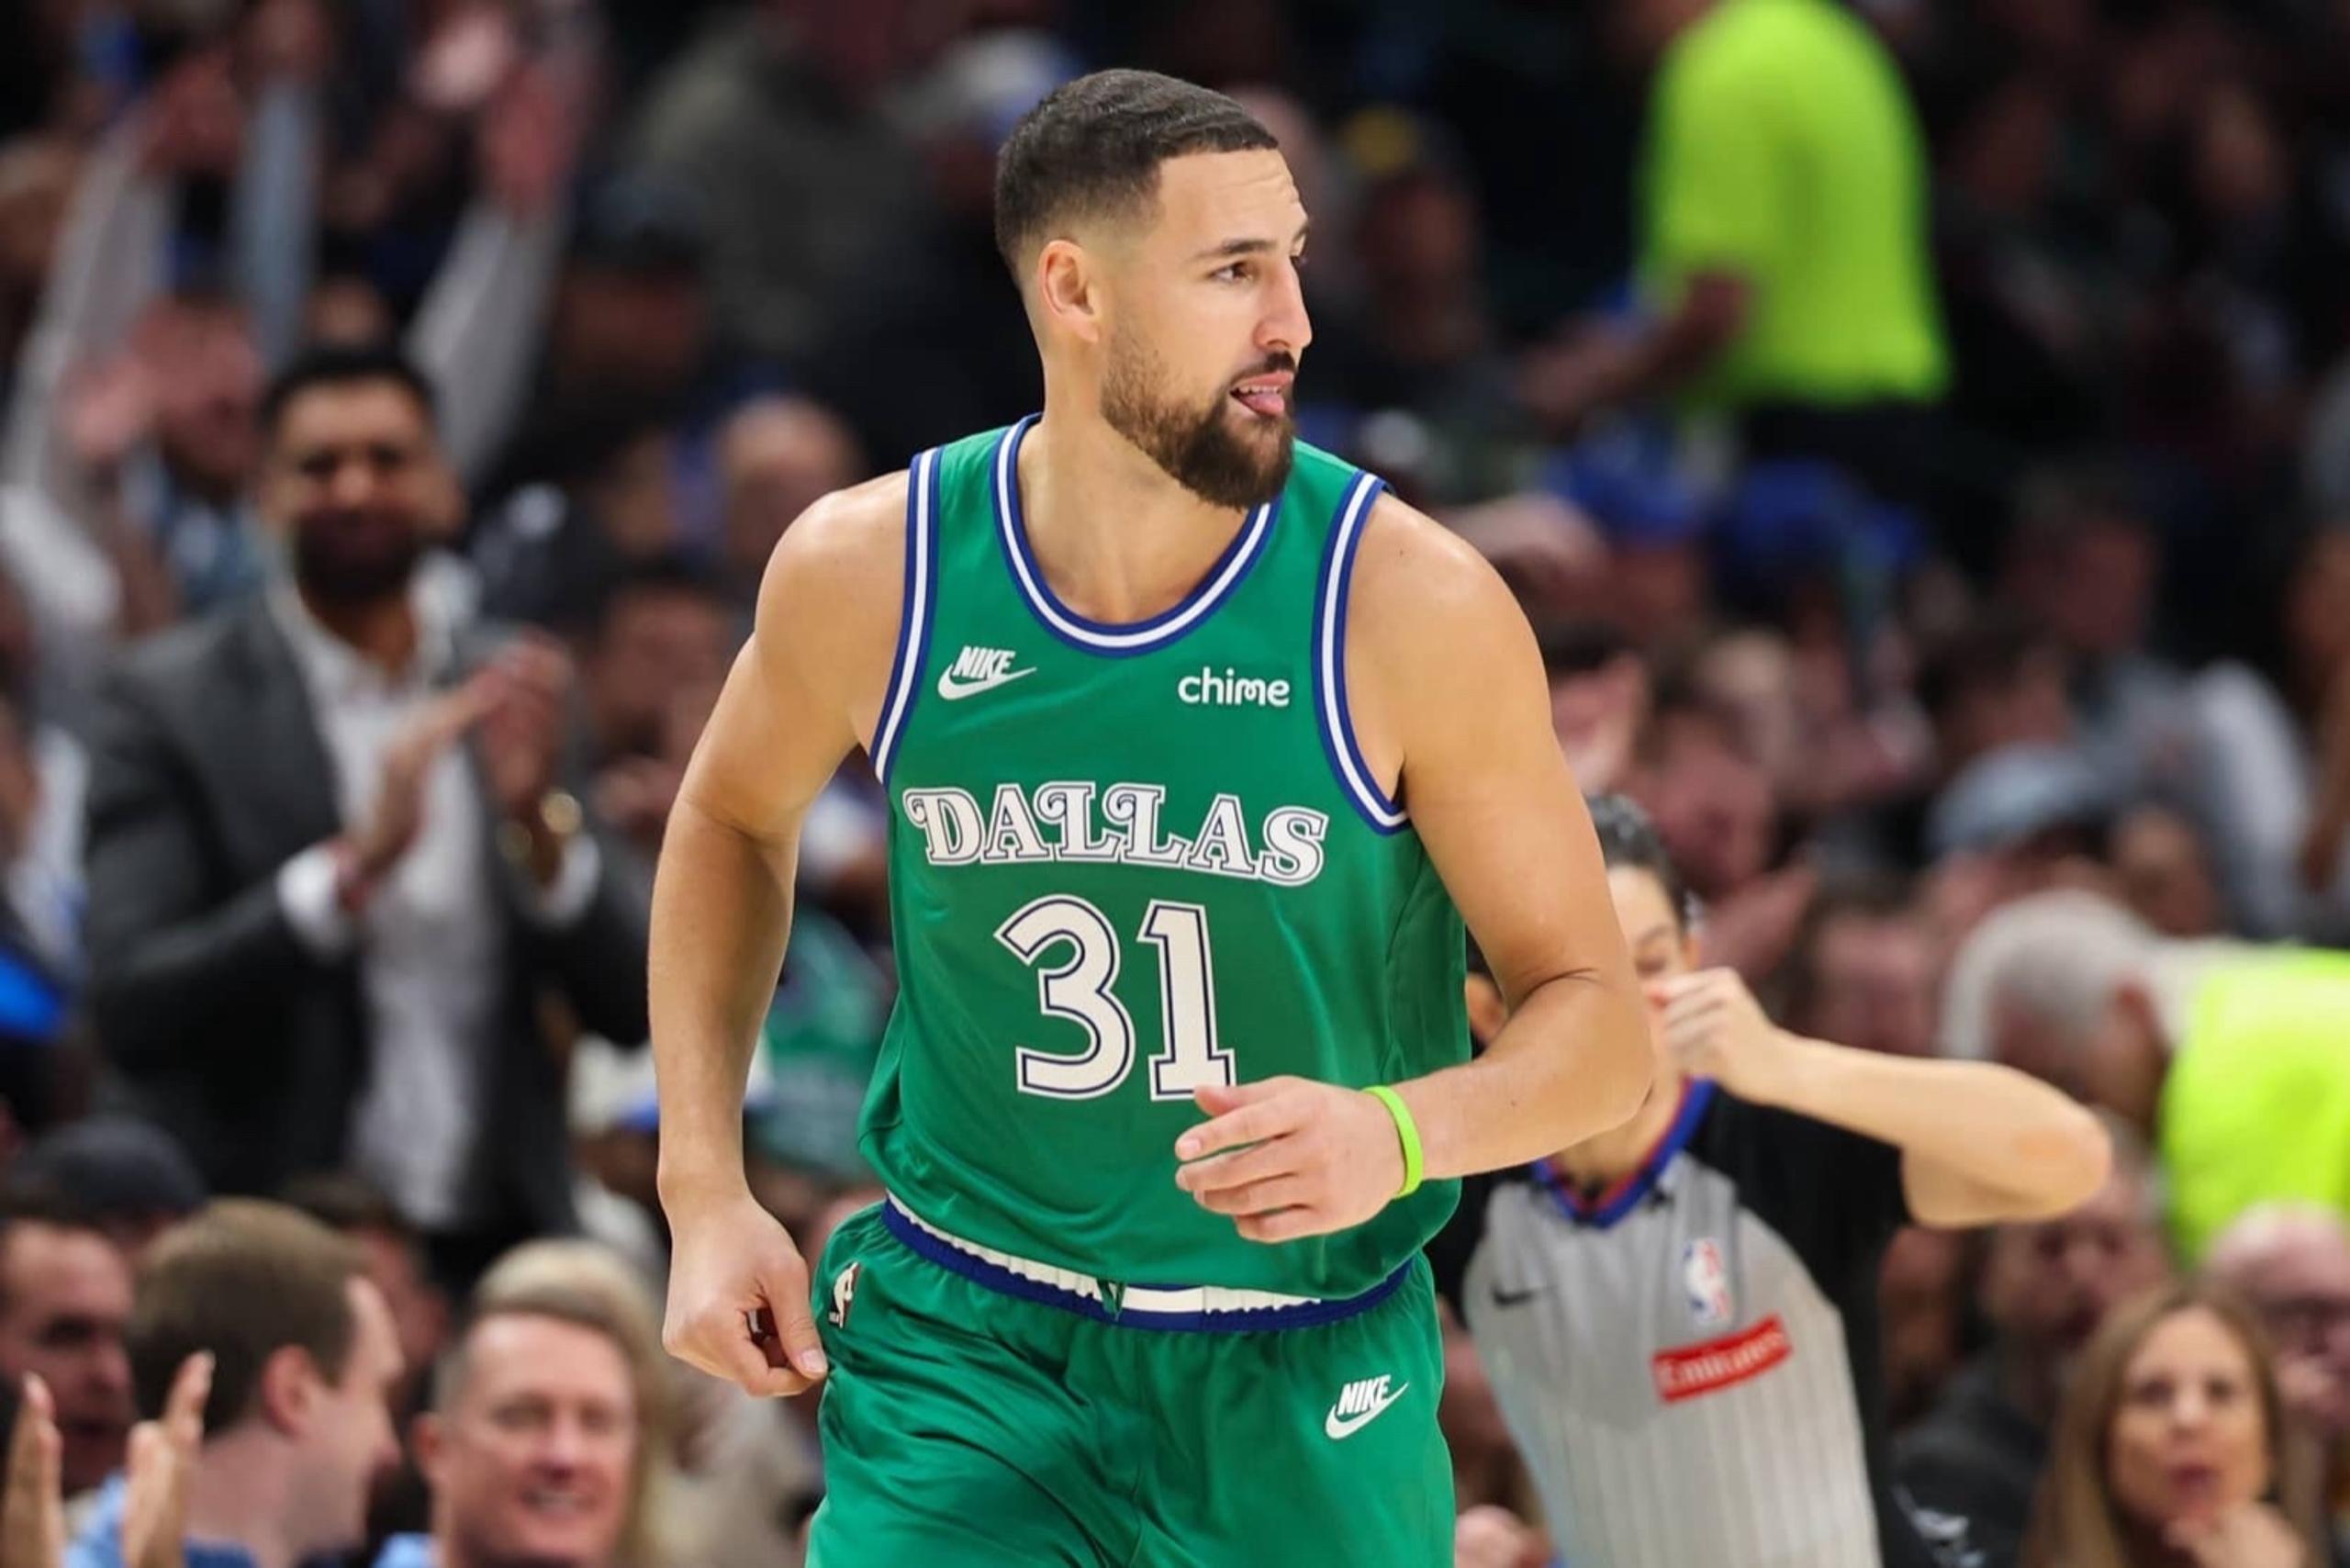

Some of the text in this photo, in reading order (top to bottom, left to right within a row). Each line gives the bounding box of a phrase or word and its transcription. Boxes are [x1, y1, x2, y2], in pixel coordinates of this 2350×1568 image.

[952, 645, 1016, 679] NIKE
[1178, 666, 1290, 707] chime
[903, 781, 1329, 887] DALLAS
[993, 893, 1237, 1102] 31
[1337, 1373, 1391, 1417] NIKE
